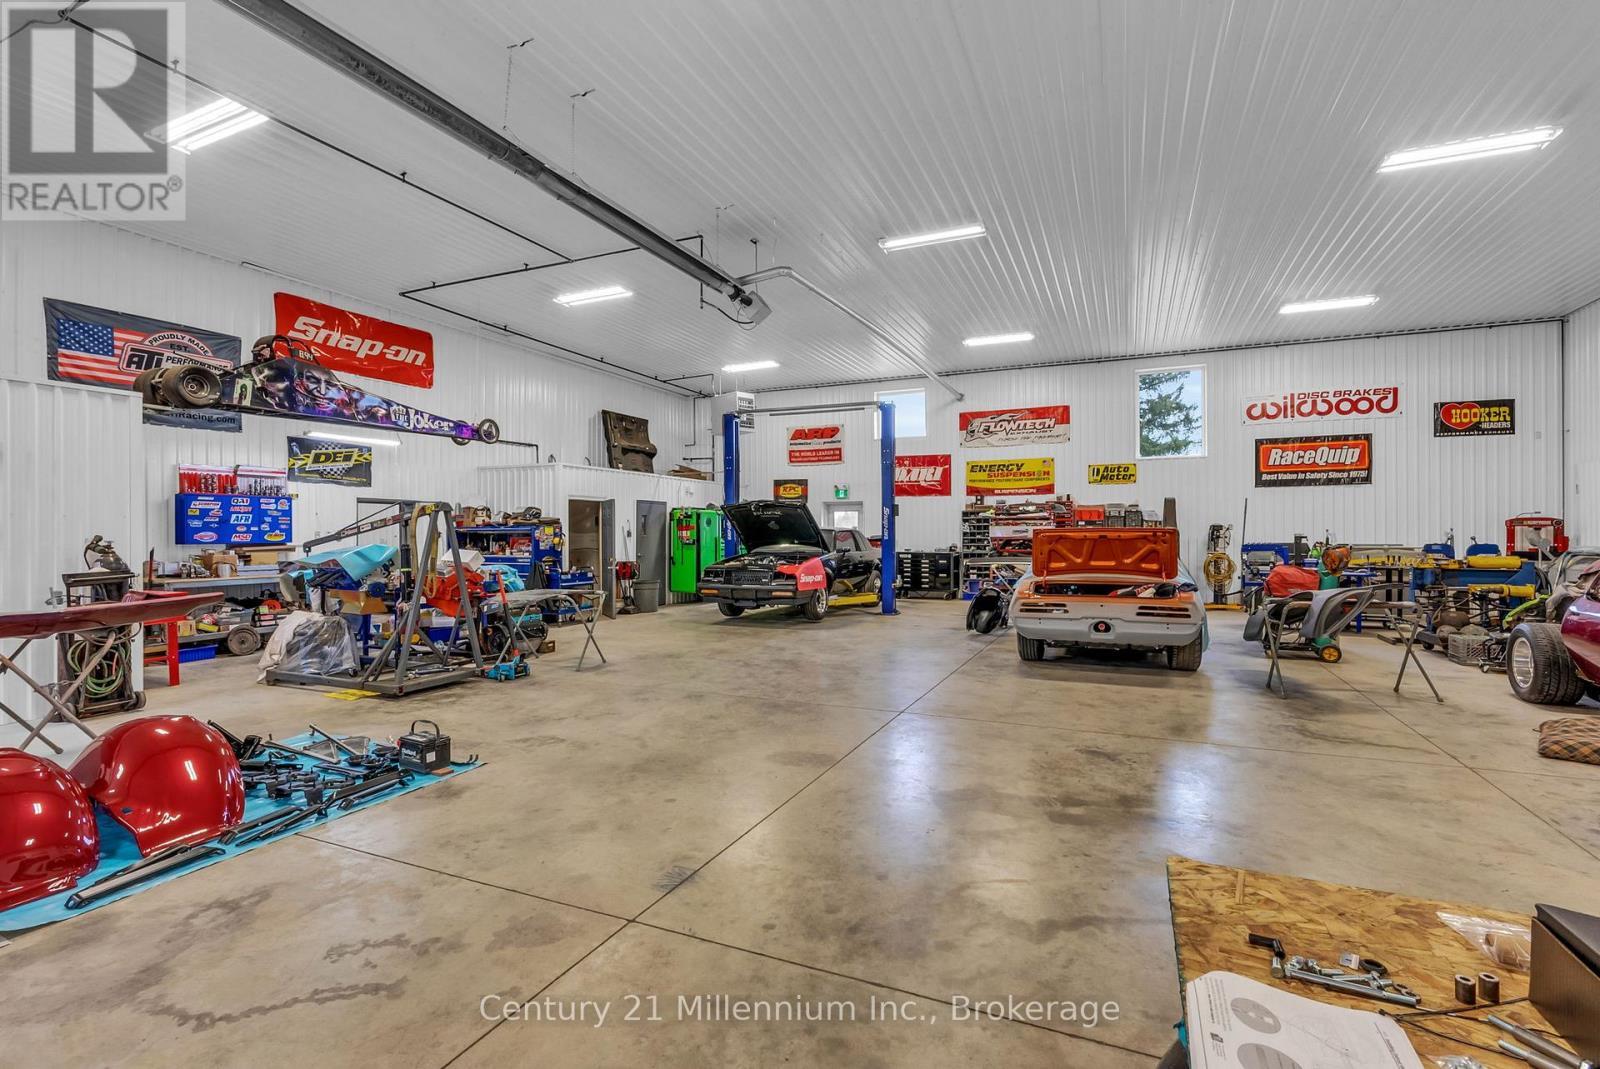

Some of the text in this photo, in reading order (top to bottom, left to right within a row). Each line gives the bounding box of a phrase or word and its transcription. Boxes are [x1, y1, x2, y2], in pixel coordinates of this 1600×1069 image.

[149, 333, 210, 356] PROUDLY MADE
[287, 315, 426, 366] Snap-on
[1296, 387, 1393, 400] DISC BRAKES
[1245, 386, 1399, 421] wilwood
[1451, 406, 1511, 423] HOOKER
[790, 427, 840, 441] ARP
[977, 418, 1056, 436] FLOWTECH
[1267, 446, 1361, 466] RaceQuip
[969, 463, 1025, 473] ENERGY
[1099, 473, 1136, 482] Meter
